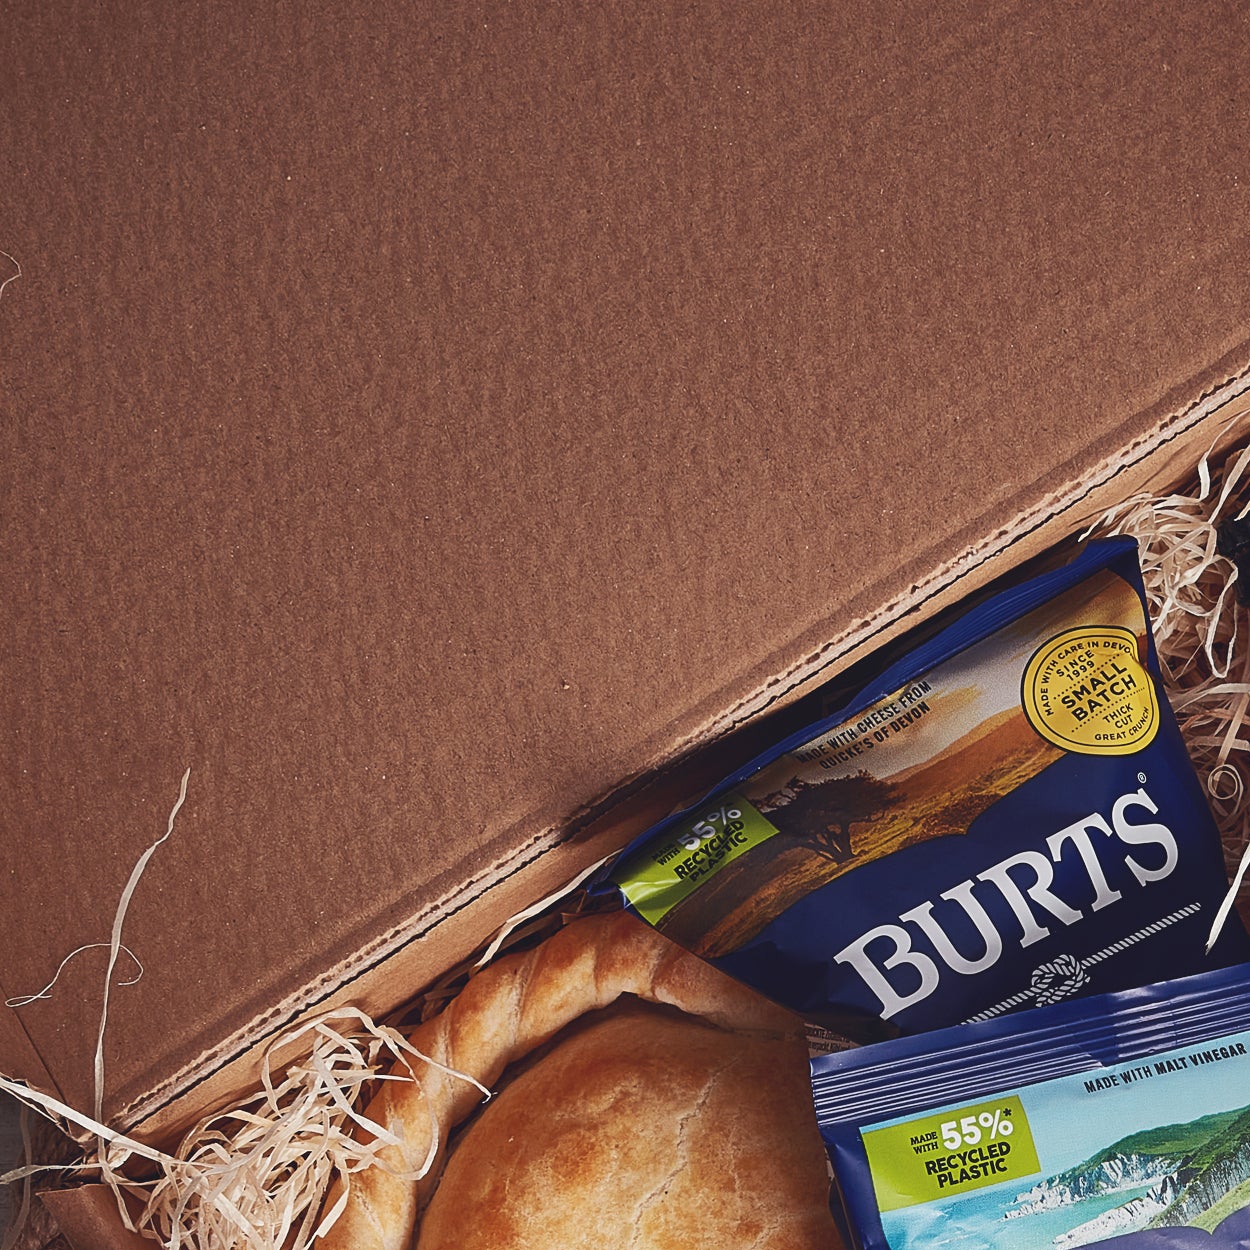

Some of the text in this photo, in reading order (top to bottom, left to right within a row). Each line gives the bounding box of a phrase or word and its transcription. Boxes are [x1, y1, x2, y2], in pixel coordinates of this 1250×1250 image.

[1040, 641, 1133, 716] MADE WITH CARE IN DEVO
[1056, 650, 1094, 677] SINCE
[1066, 660, 1095, 681] 1999
[1061, 662, 1127, 709] SMALL
[1071, 674, 1137, 721] BATCH
[796, 680, 932, 764] MADE WITH CHEESE FROM
[1094, 706, 1149, 741] GREAT CRUNCH
[1102, 703, 1134, 723] THICK
[1114, 714, 1134, 729] CUT
[819, 701, 931, 769] QUICKE'S OF DEVON
[657, 847, 680, 866] WITH
[673, 820, 745, 880] RECYCLED
[688, 832, 748, 882] PLASTIC
[1083, 1042, 1248, 1094] MADE WITH MALT VINEGAR
[910, 1131, 939, 1146] MADE
[913, 1141, 939, 1155] WITH
[924, 1141, 1011, 1176] RECYCLED
[936, 1157, 1008, 1189] PLASTIC
